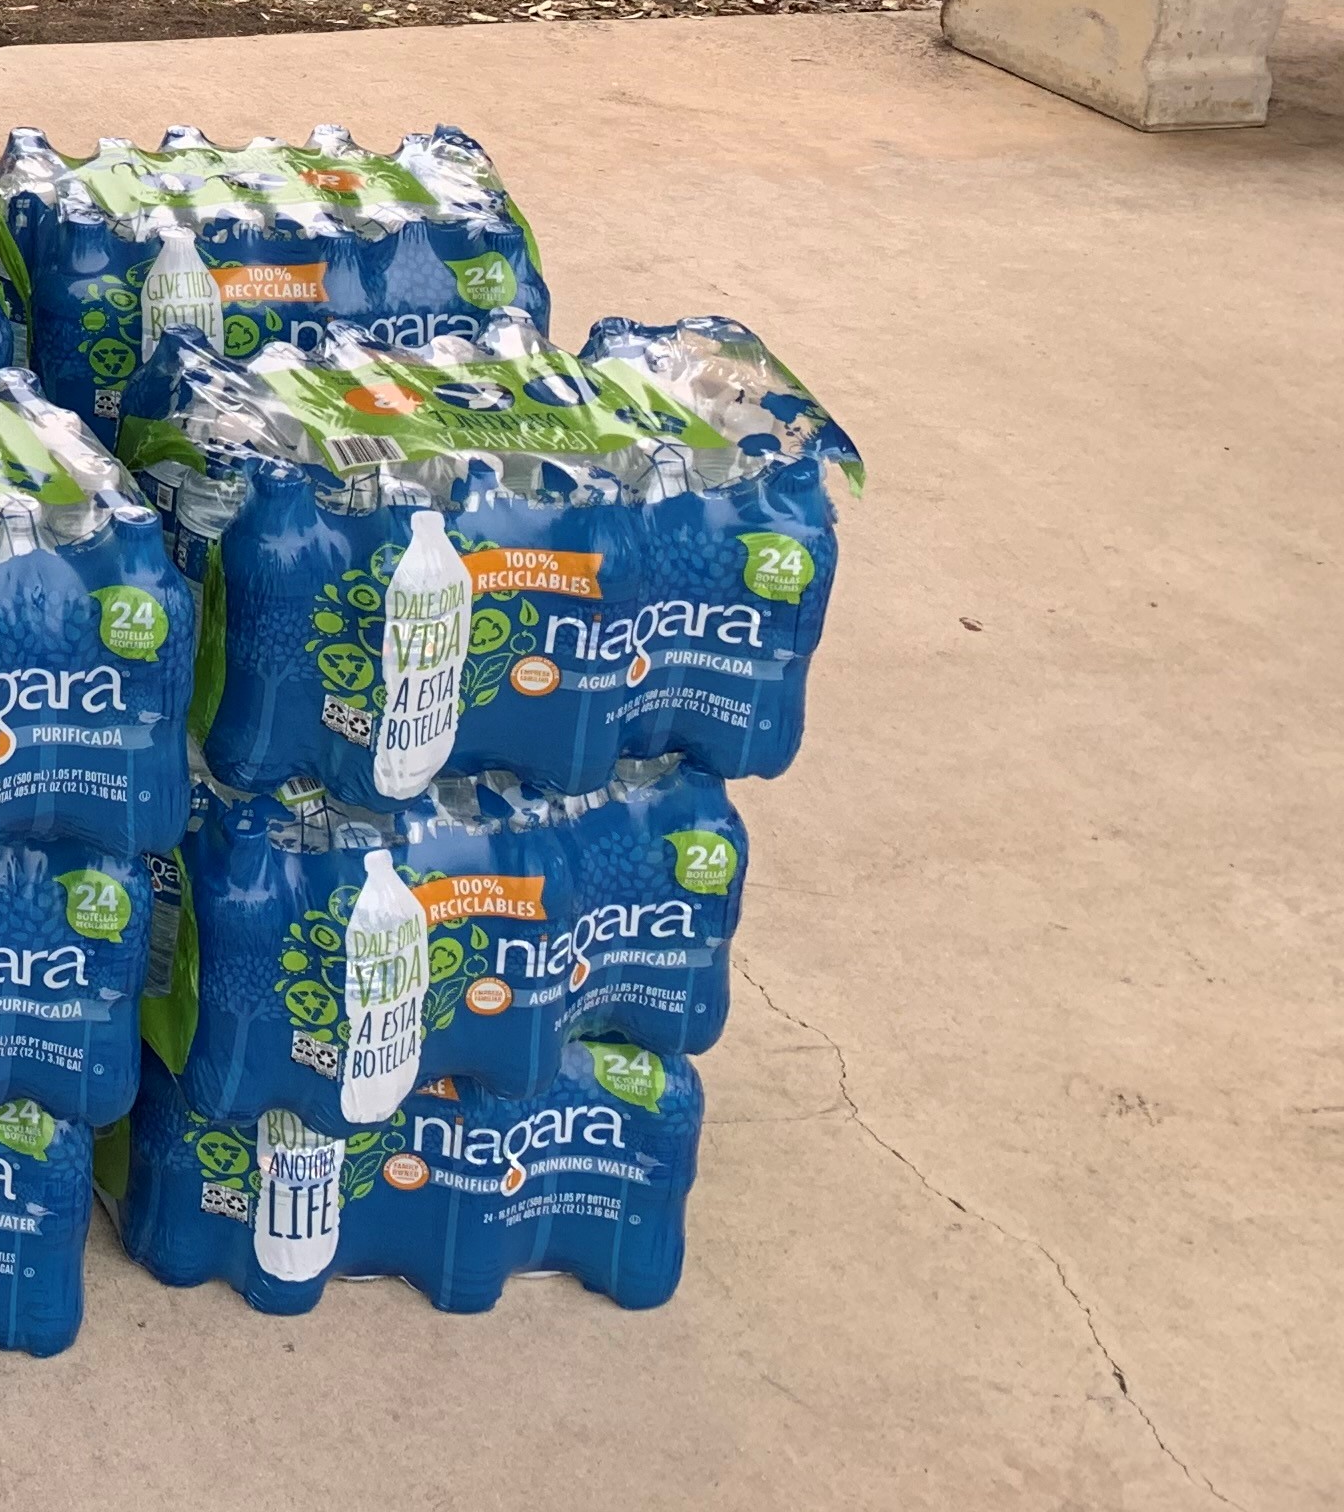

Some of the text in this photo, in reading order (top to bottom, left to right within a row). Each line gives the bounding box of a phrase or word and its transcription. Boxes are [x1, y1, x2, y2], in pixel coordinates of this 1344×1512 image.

[147, 271, 212, 300] GIVE THIS
[248, 267, 291, 282] 100%
[465, 262, 505, 284] 24
[225, 282, 318, 298] RECYCLABLE
[505, 552, 558, 570] 100%
[757, 548, 803, 575] 24
[478, 571, 590, 594] RECICLABLES
[755, 573, 801, 584] BOTELLAS
[393, 580, 464, 620] DALE OTRA
[110, 602, 154, 630] 24
[111, 630, 154, 640] BOTELLAS
[392, 612, 460, 673] VIDA
[544, 600, 762, 687] niagara
[578, 652, 753, 688] AGUA PURIFICADA
[392, 666, 453, 713] A ESTA
[32, 727, 122, 746] PURIFICADA
[387, 703, 452, 750] BOTELLA
[52, 769, 70, 780] 1.05
[72, 770, 83, 781] PT
[85, 771, 128, 787] BOTELLAS
[110, 787, 128, 802] GAL
[686, 844, 727, 870] 24
[452, 879, 503, 896] 100%
[686, 870, 726, 878] BOTELLAS
[76, 885, 118, 911] 24
[430, 897, 536, 921] RECICLABLES
[76, 911, 118, 922] BOTELLAS
[353, 914, 421, 959] DALE OTRA
[496, 900, 695, 993] niagara
[355, 945, 421, 1008] VIDA
[529, 951, 687, 1005] AGUA PURIFICADA
[357, 997, 416, 1045] A ESTA
[352, 1031, 416, 1079] BOTELLA
[604, 1050, 652, 1076] 24
[613, 1083, 648, 1096] BOTTLES
[414, 1105, 625, 1197] niagara
[269, 1148, 336, 1182] ANOTHER
[435, 1157, 645, 1192] PURIFIED DRINKING WATER
[269, 1179, 333, 1240] LIFE
